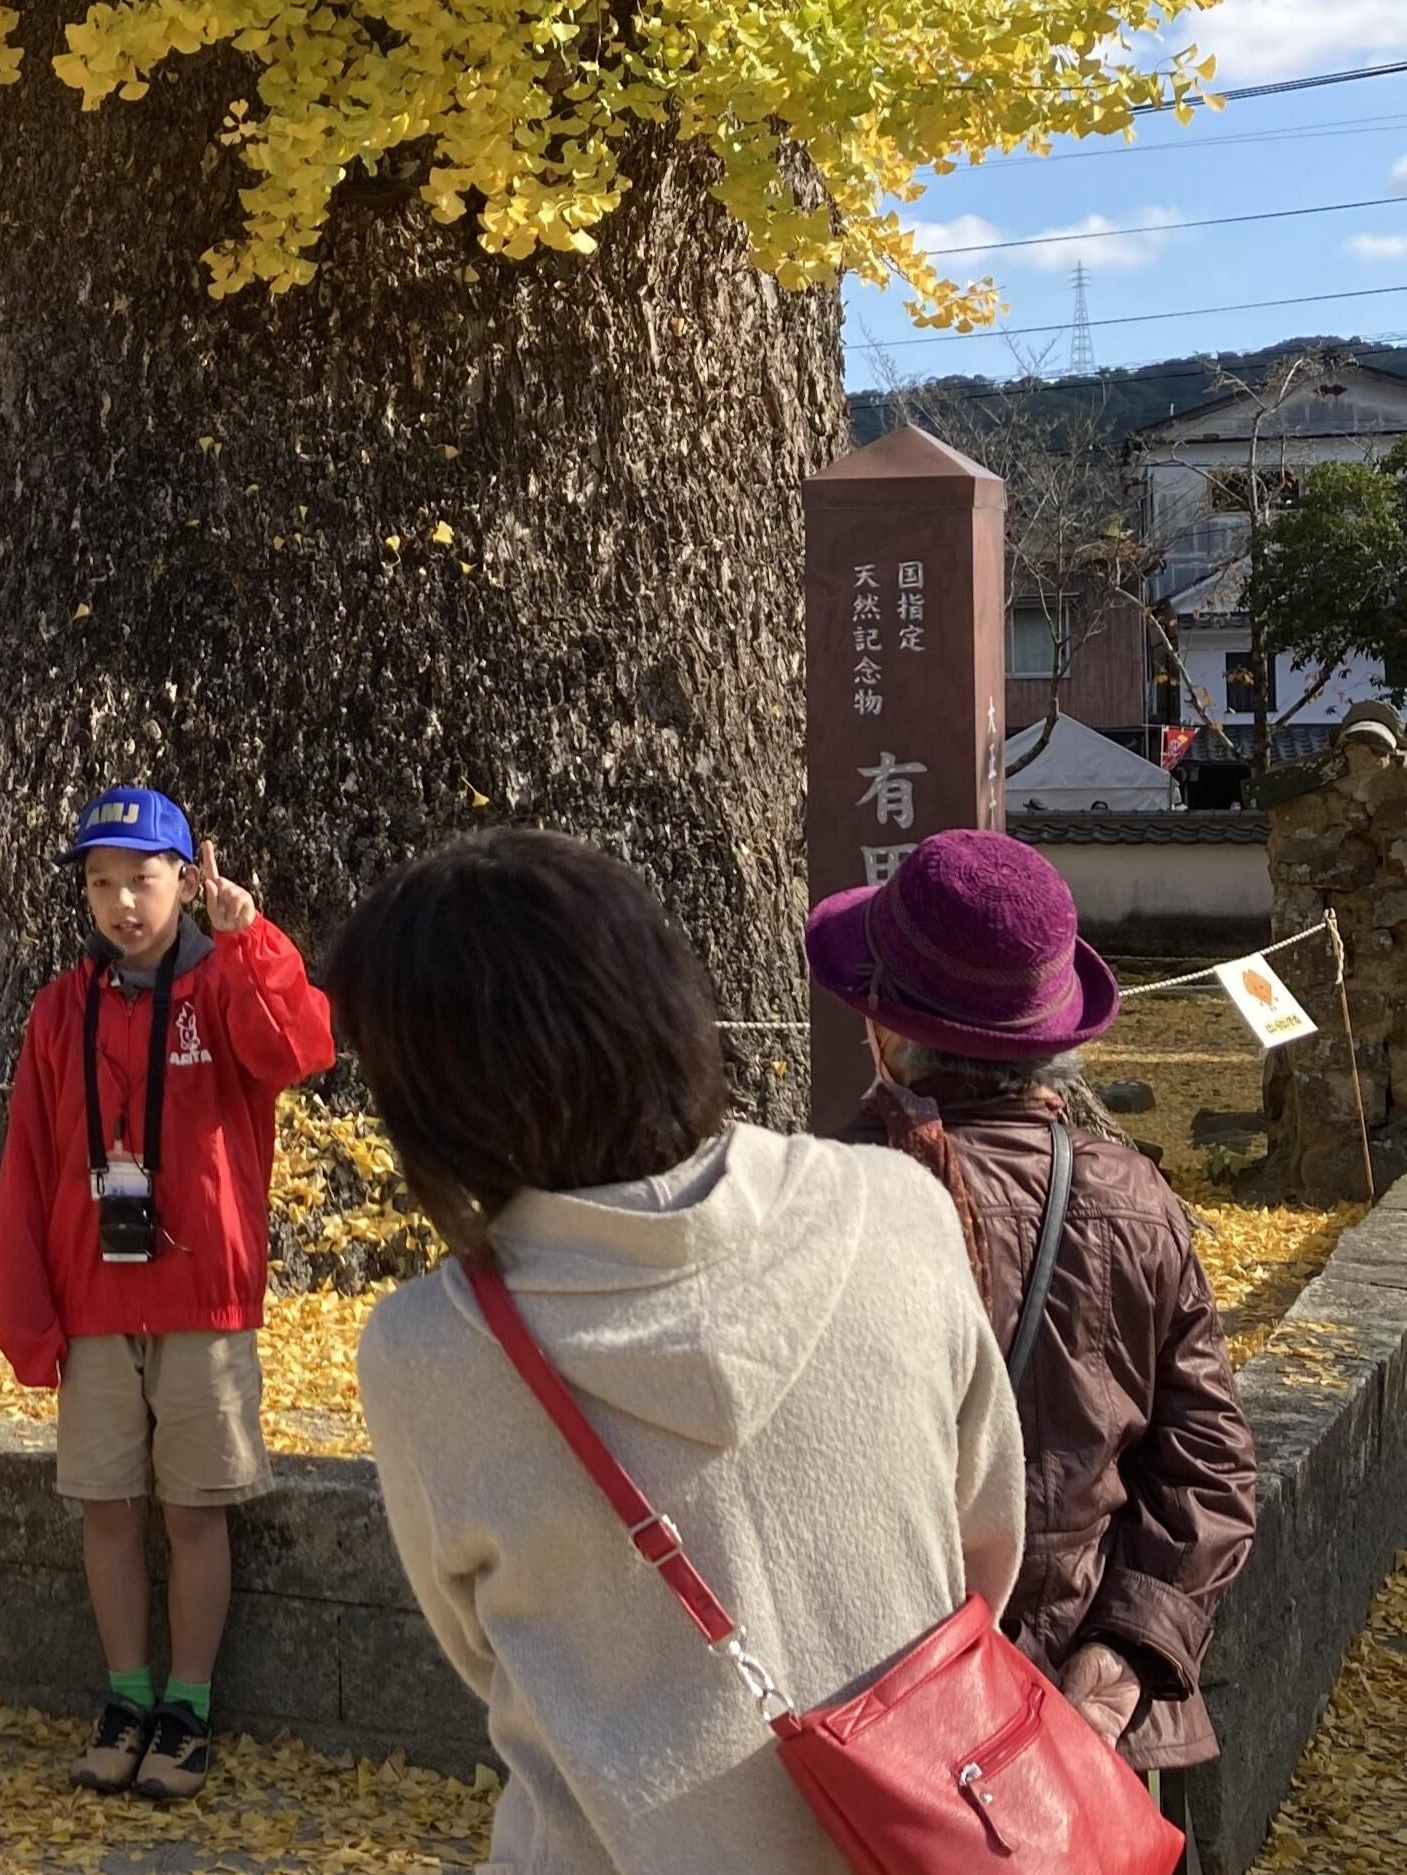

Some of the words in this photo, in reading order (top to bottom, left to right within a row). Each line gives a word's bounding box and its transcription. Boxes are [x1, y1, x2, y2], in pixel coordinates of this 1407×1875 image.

[852, 564, 883, 715] 天然記念物
[896, 560, 926, 651] 国指定
